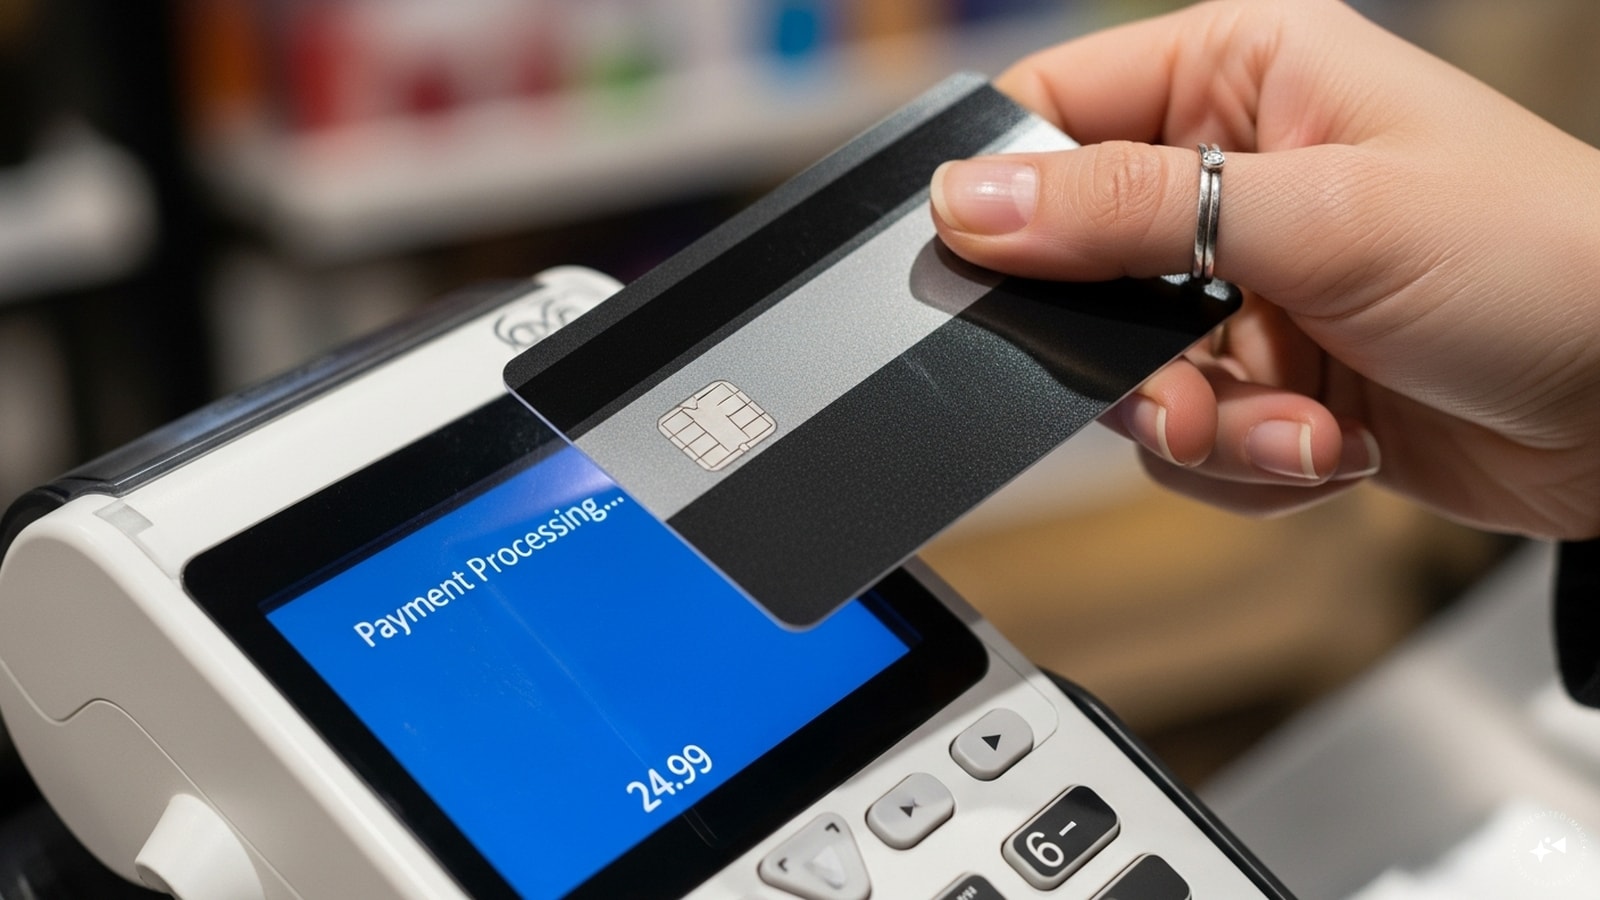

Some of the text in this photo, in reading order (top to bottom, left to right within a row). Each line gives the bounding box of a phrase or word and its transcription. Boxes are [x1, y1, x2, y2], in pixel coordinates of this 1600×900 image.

[353, 496, 625, 648] Payment Processing...
[625, 743, 713, 813] 24.99
